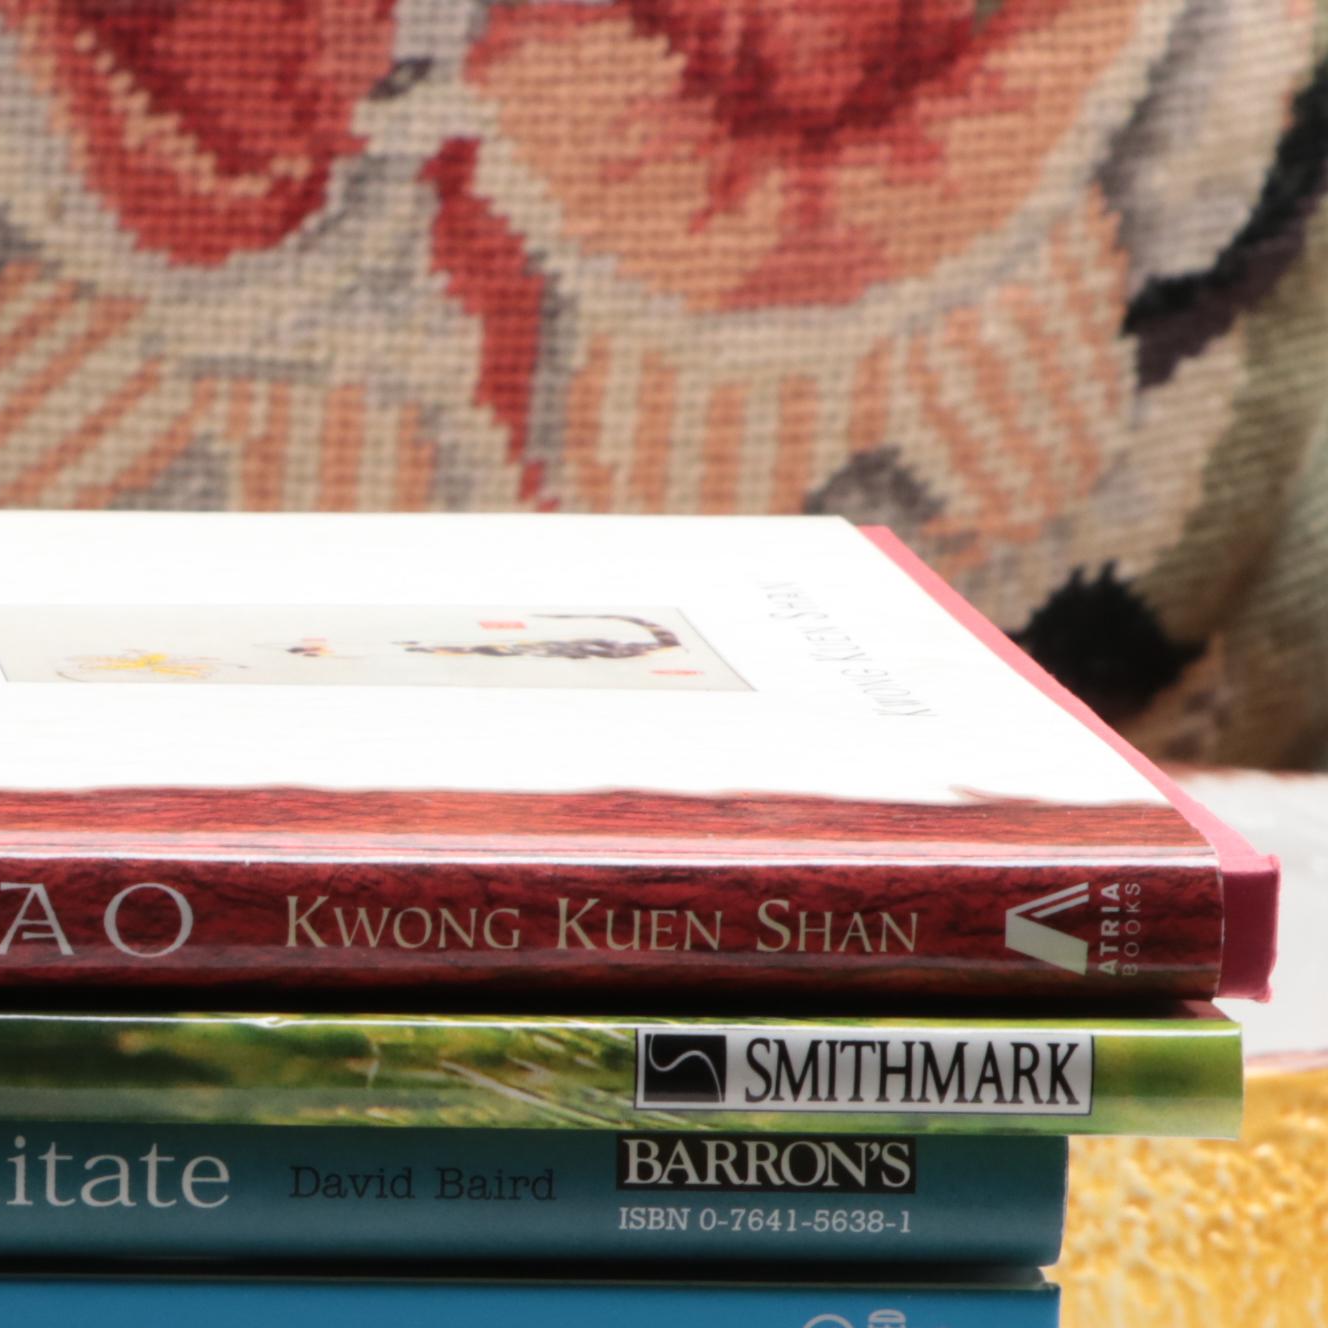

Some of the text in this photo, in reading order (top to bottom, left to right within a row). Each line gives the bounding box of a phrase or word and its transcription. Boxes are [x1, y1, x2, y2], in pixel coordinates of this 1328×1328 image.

[1098, 883, 1120, 976] ATRIA
[1123, 883, 1142, 976] BOOKS
[745, 1037, 1080, 1105] SMITHMARK
[288, 1165, 557, 1202] David Baird
[623, 1138, 911, 1188] BARRON'S
[618, 1207, 911, 1233] ISBN 0-7641-5638-1
